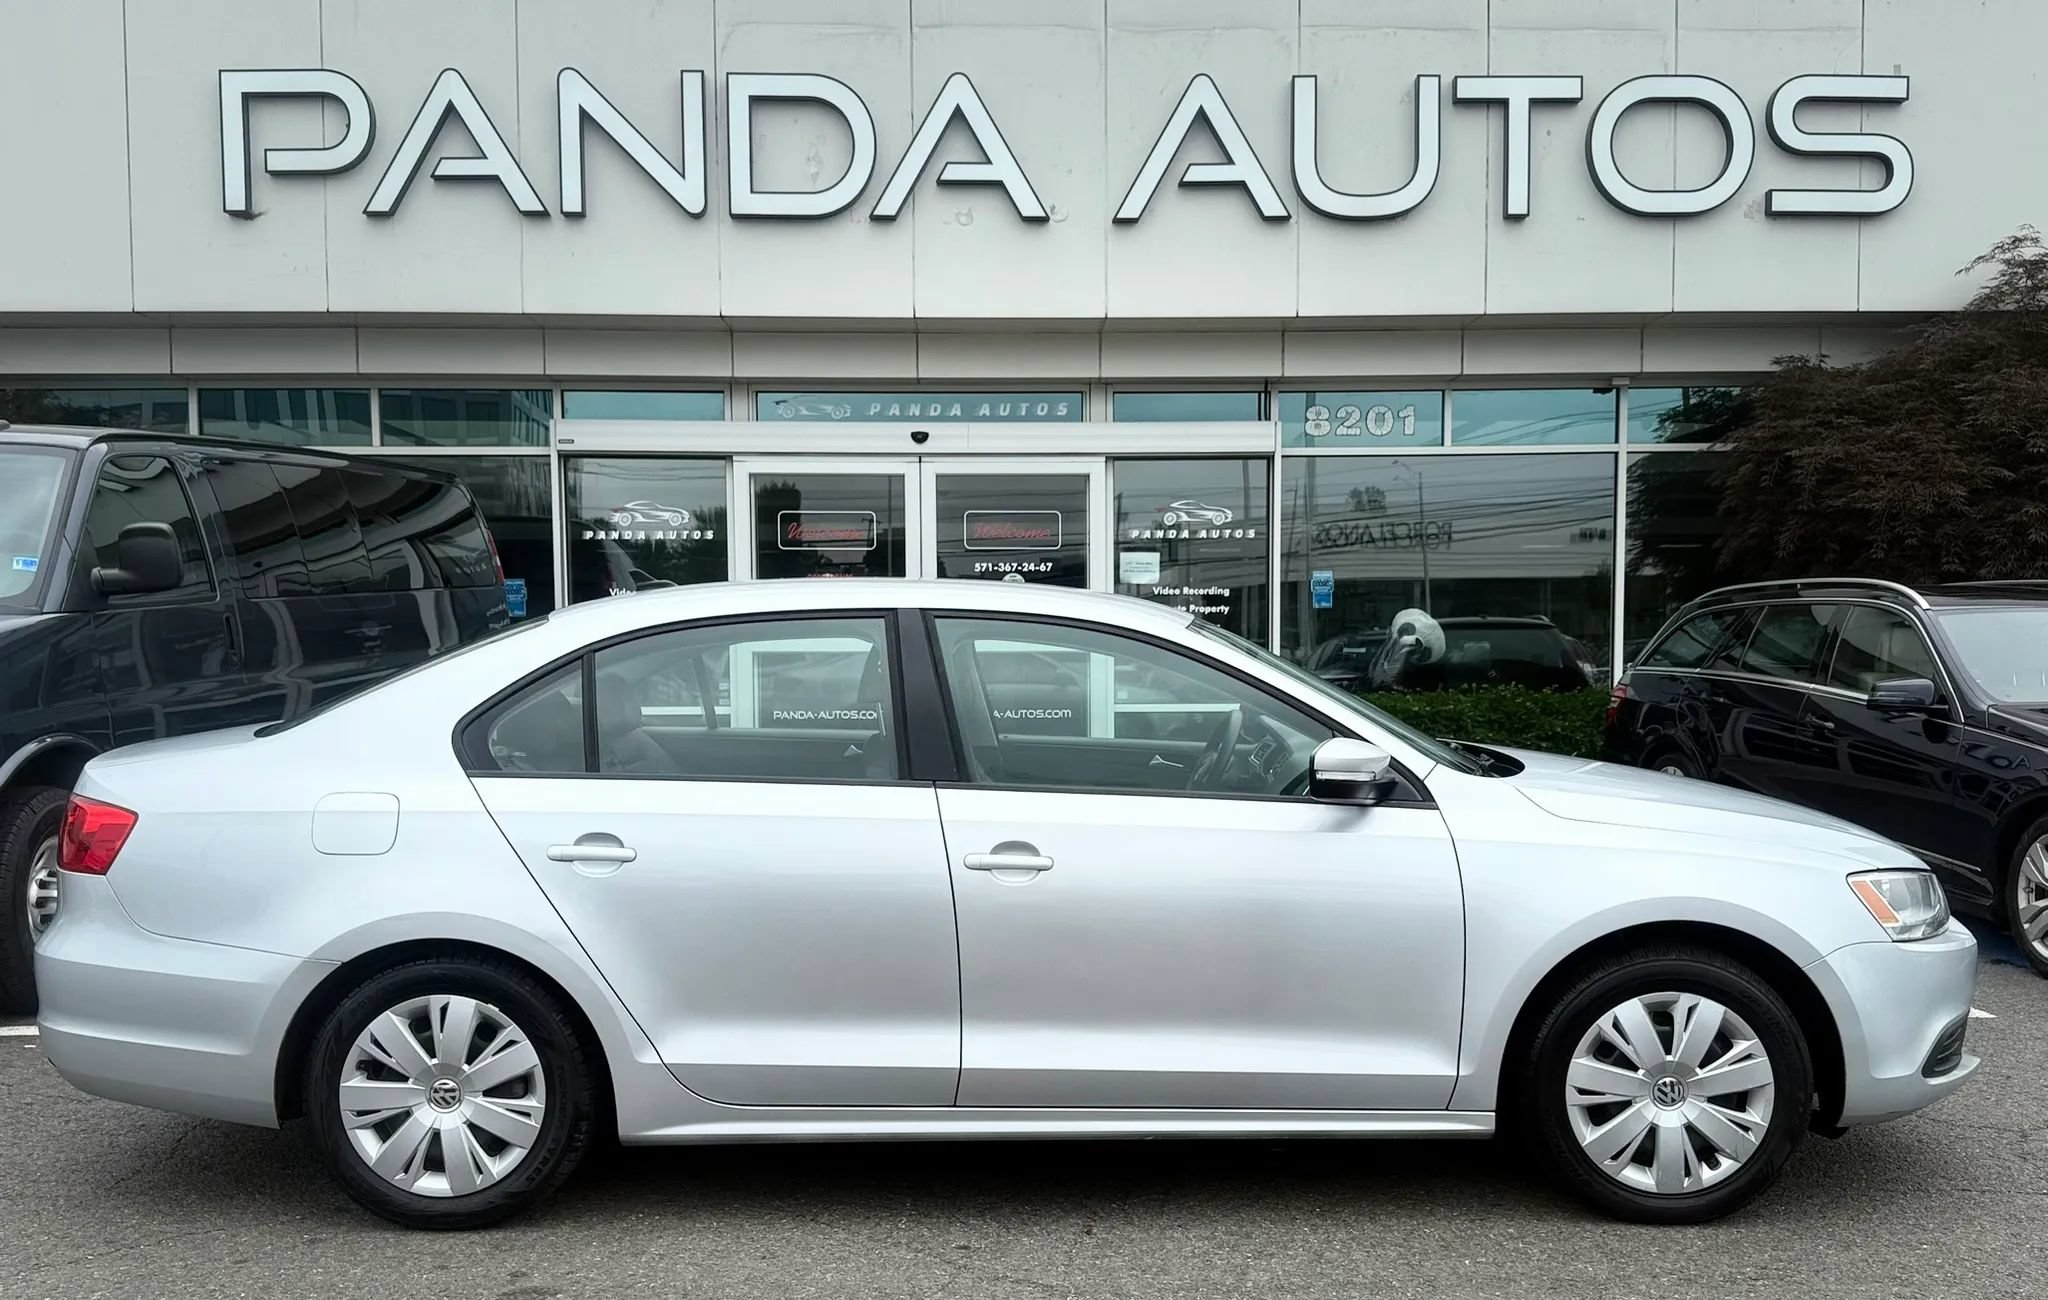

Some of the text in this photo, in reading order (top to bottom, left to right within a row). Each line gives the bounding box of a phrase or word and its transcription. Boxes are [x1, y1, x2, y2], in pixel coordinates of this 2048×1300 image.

[218, 67, 1914, 223] PANDA AUTOS
[867, 402, 1069, 417] PANDA AUTOS
[1305, 404, 1416, 436] 8201
[583, 529, 715, 541] PANDA AUTOS
[1130, 529, 1257, 540] PANDA AUTOS
[974, 562, 1053, 573] 571-367-24-67
[1152, 586, 1231, 597] Video Recording
[1189, 604, 1230, 615] Property
